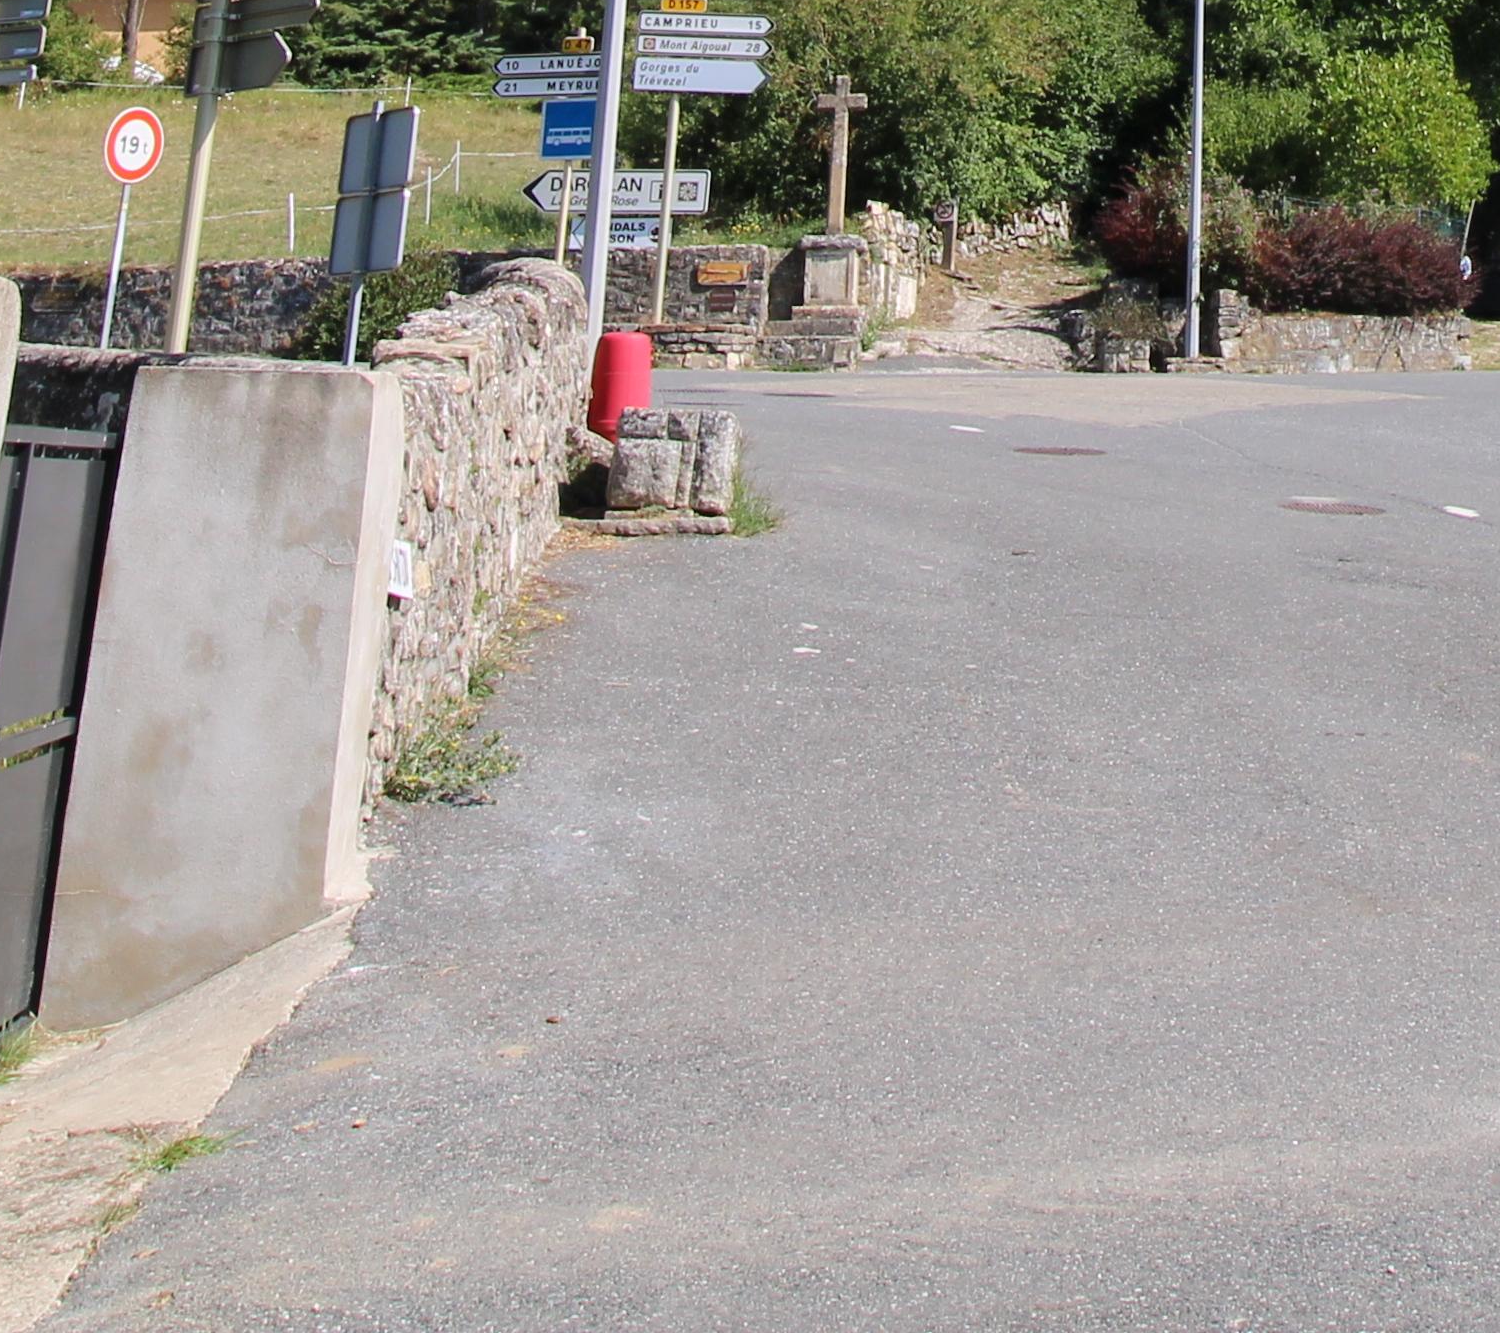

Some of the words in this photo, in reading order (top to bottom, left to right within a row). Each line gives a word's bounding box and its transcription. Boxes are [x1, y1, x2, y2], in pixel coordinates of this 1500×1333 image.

[669, 0, 676, 10] D
[680, 0, 700, 10] 157
[644, 16, 719, 29] CAMPRIEU
[749, 20, 763, 30] 15
[575, 39, 591, 51] 47
[659, 39, 687, 51] Mont
[690, 41, 732, 54] Aigoual
[745, 42, 762, 54] 28
[505, 60, 520, 71] 10
[540, 57, 601, 70] LANUÉJO
[639, 60, 680, 75] Gorges
[685, 62, 700, 74] du
[504, 82, 518, 93] 21
[546, 79, 598, 93] MEYRU
[638, 74, 688, 87] Trévezel
[120, 135, 140, 155] 19
[143, 142, 149, 155] t
